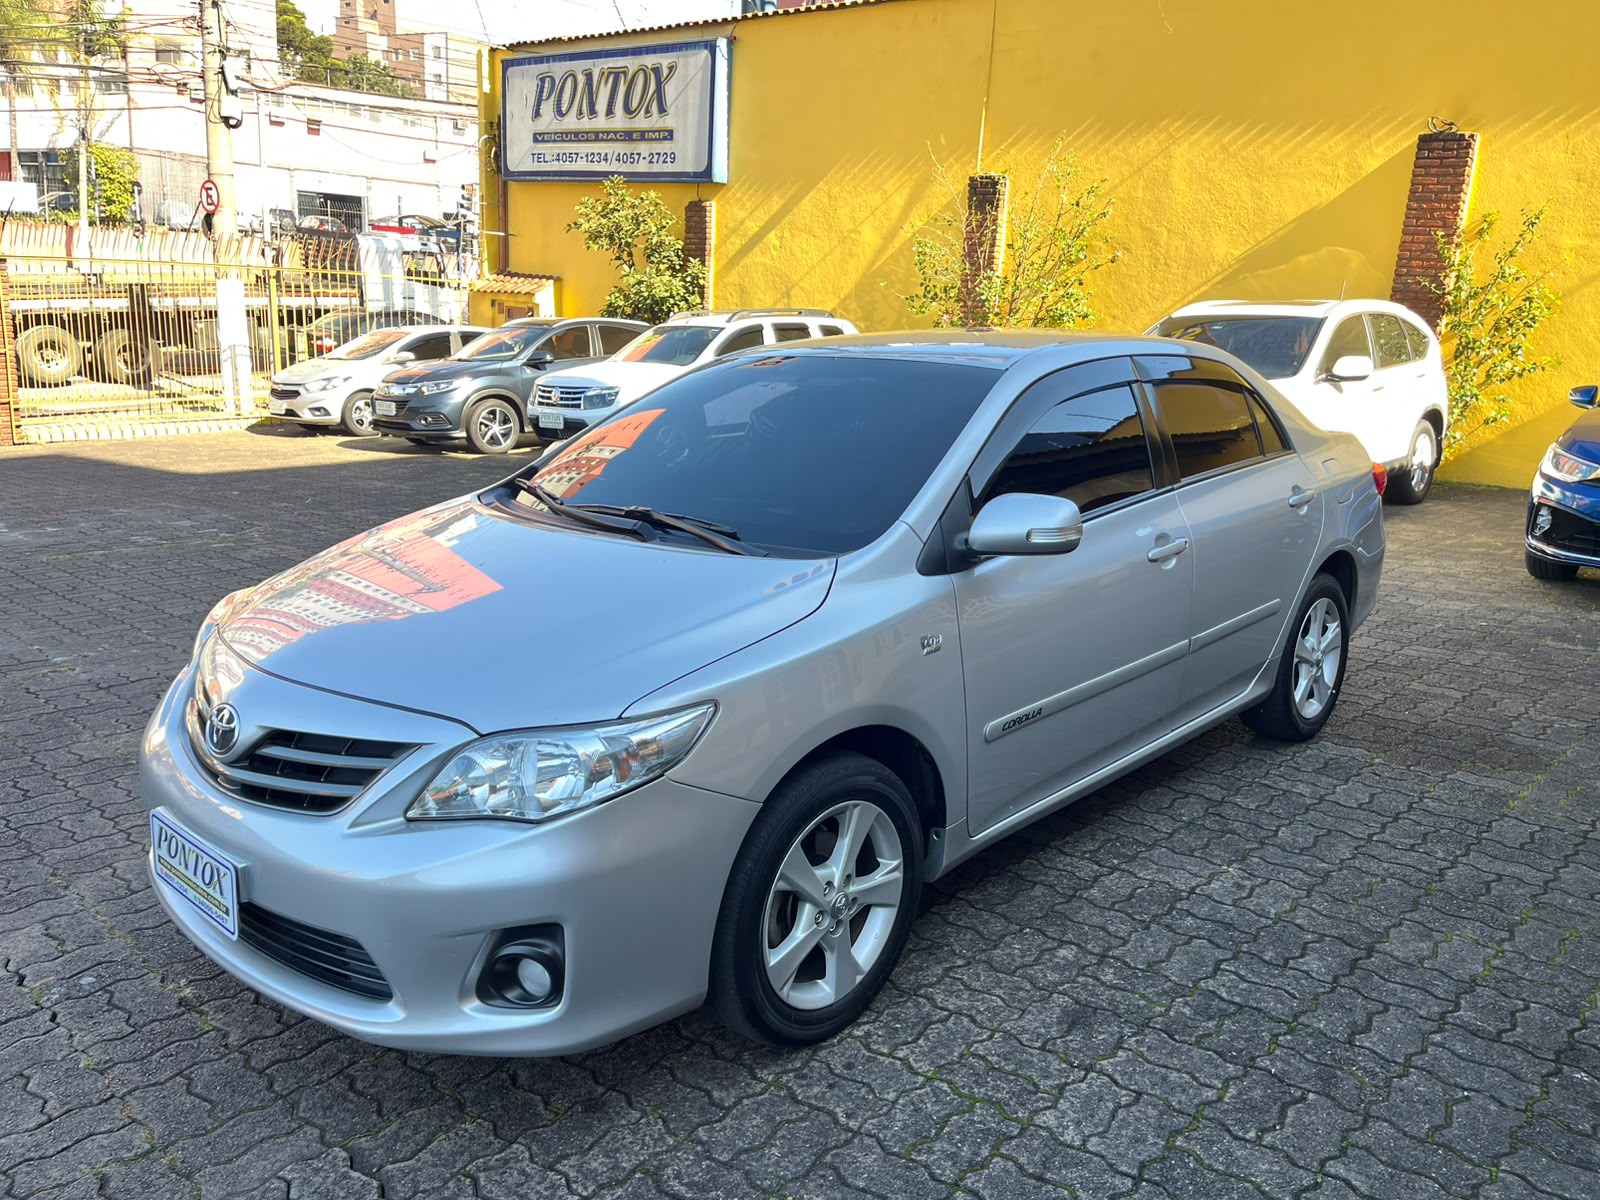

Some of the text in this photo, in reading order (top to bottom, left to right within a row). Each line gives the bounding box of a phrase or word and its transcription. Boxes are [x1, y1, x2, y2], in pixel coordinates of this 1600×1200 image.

[532, 60, 678, 122] PONTOX
[598, 132, 629, 140] NAC.
[632, 131, 641, 139] E
[645, 131, 671, 139] IMP.
[1002, 707, 1043, 731] COROLLA
[157, 824, 228, 899] PONTOX
